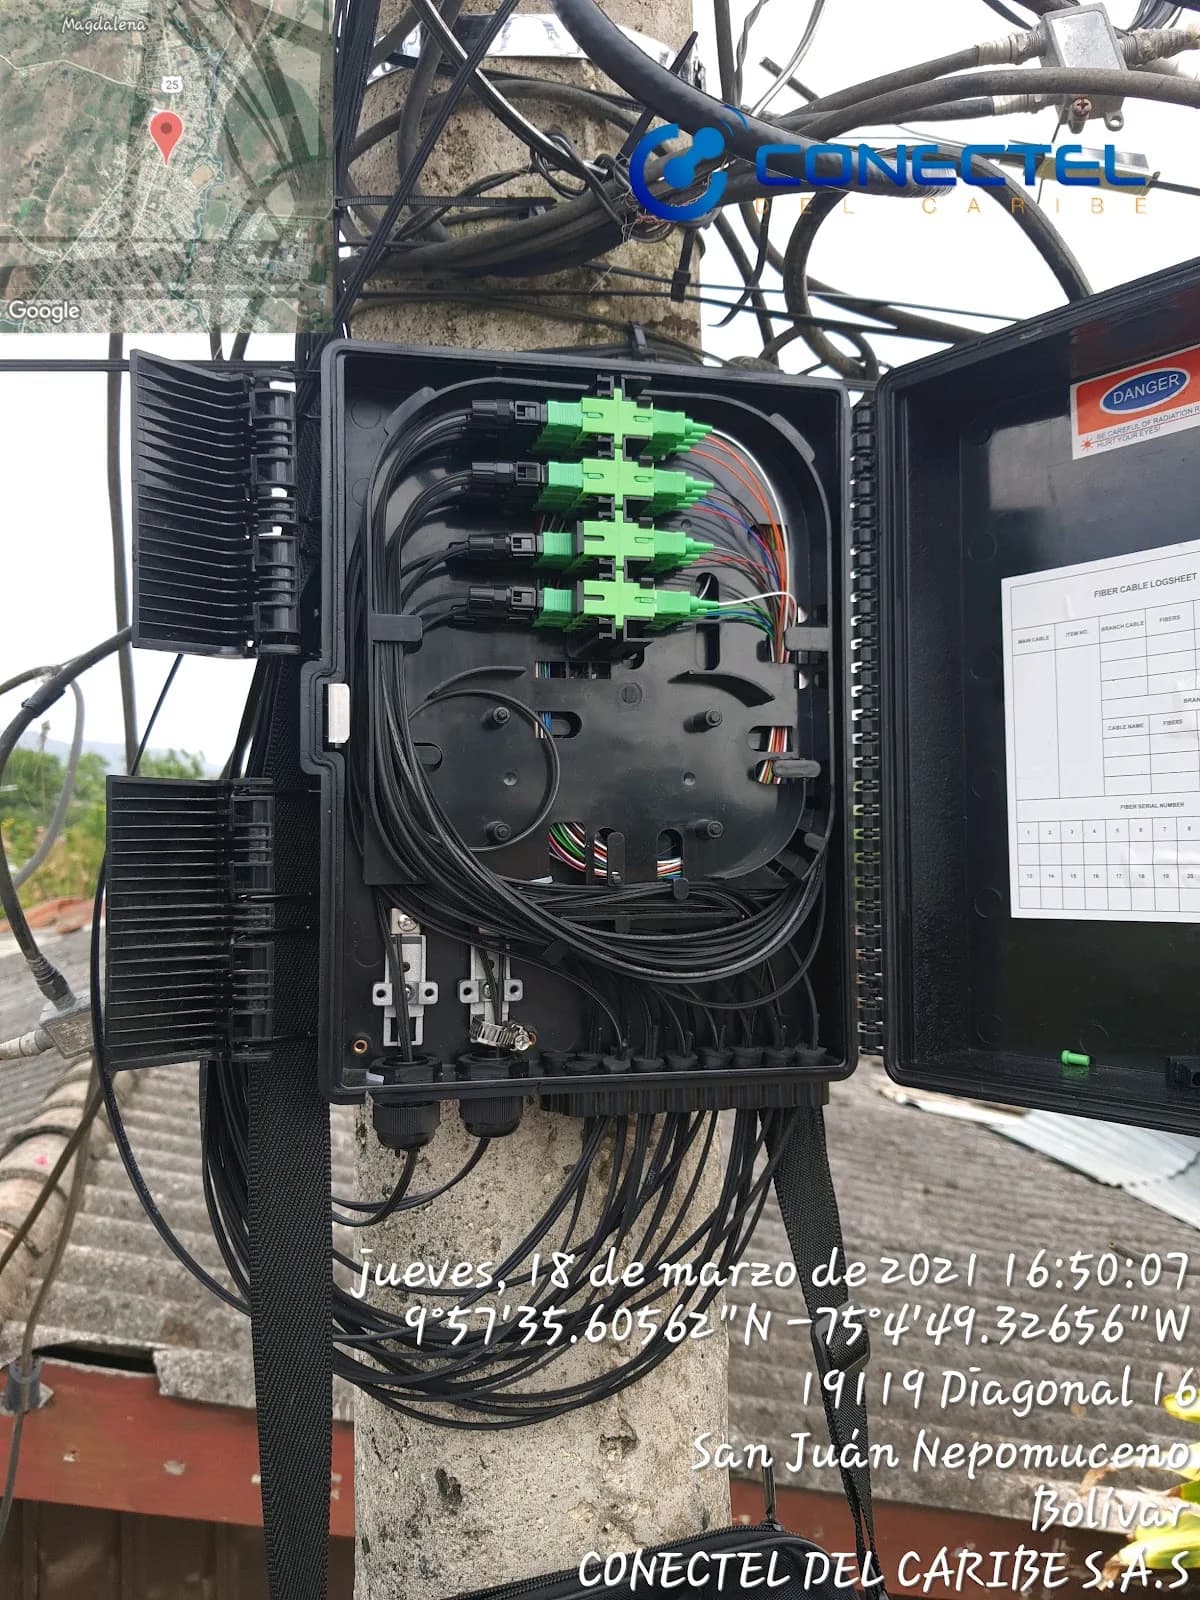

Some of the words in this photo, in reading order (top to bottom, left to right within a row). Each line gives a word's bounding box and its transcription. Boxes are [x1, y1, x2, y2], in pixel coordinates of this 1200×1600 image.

[1112, 374, 1180, 405] DANGER
[1153, 407, 1193, 424] RADIATION
[1094, 585, 1118, 598] FIBER
[1120, 579, 1148, 593] CABLE
[1150, 573, 1198, 588] LOGSHEET
[1125, 620, 1144, 628] CABLE
[1159, 615, 1181, 623] FIBERS
